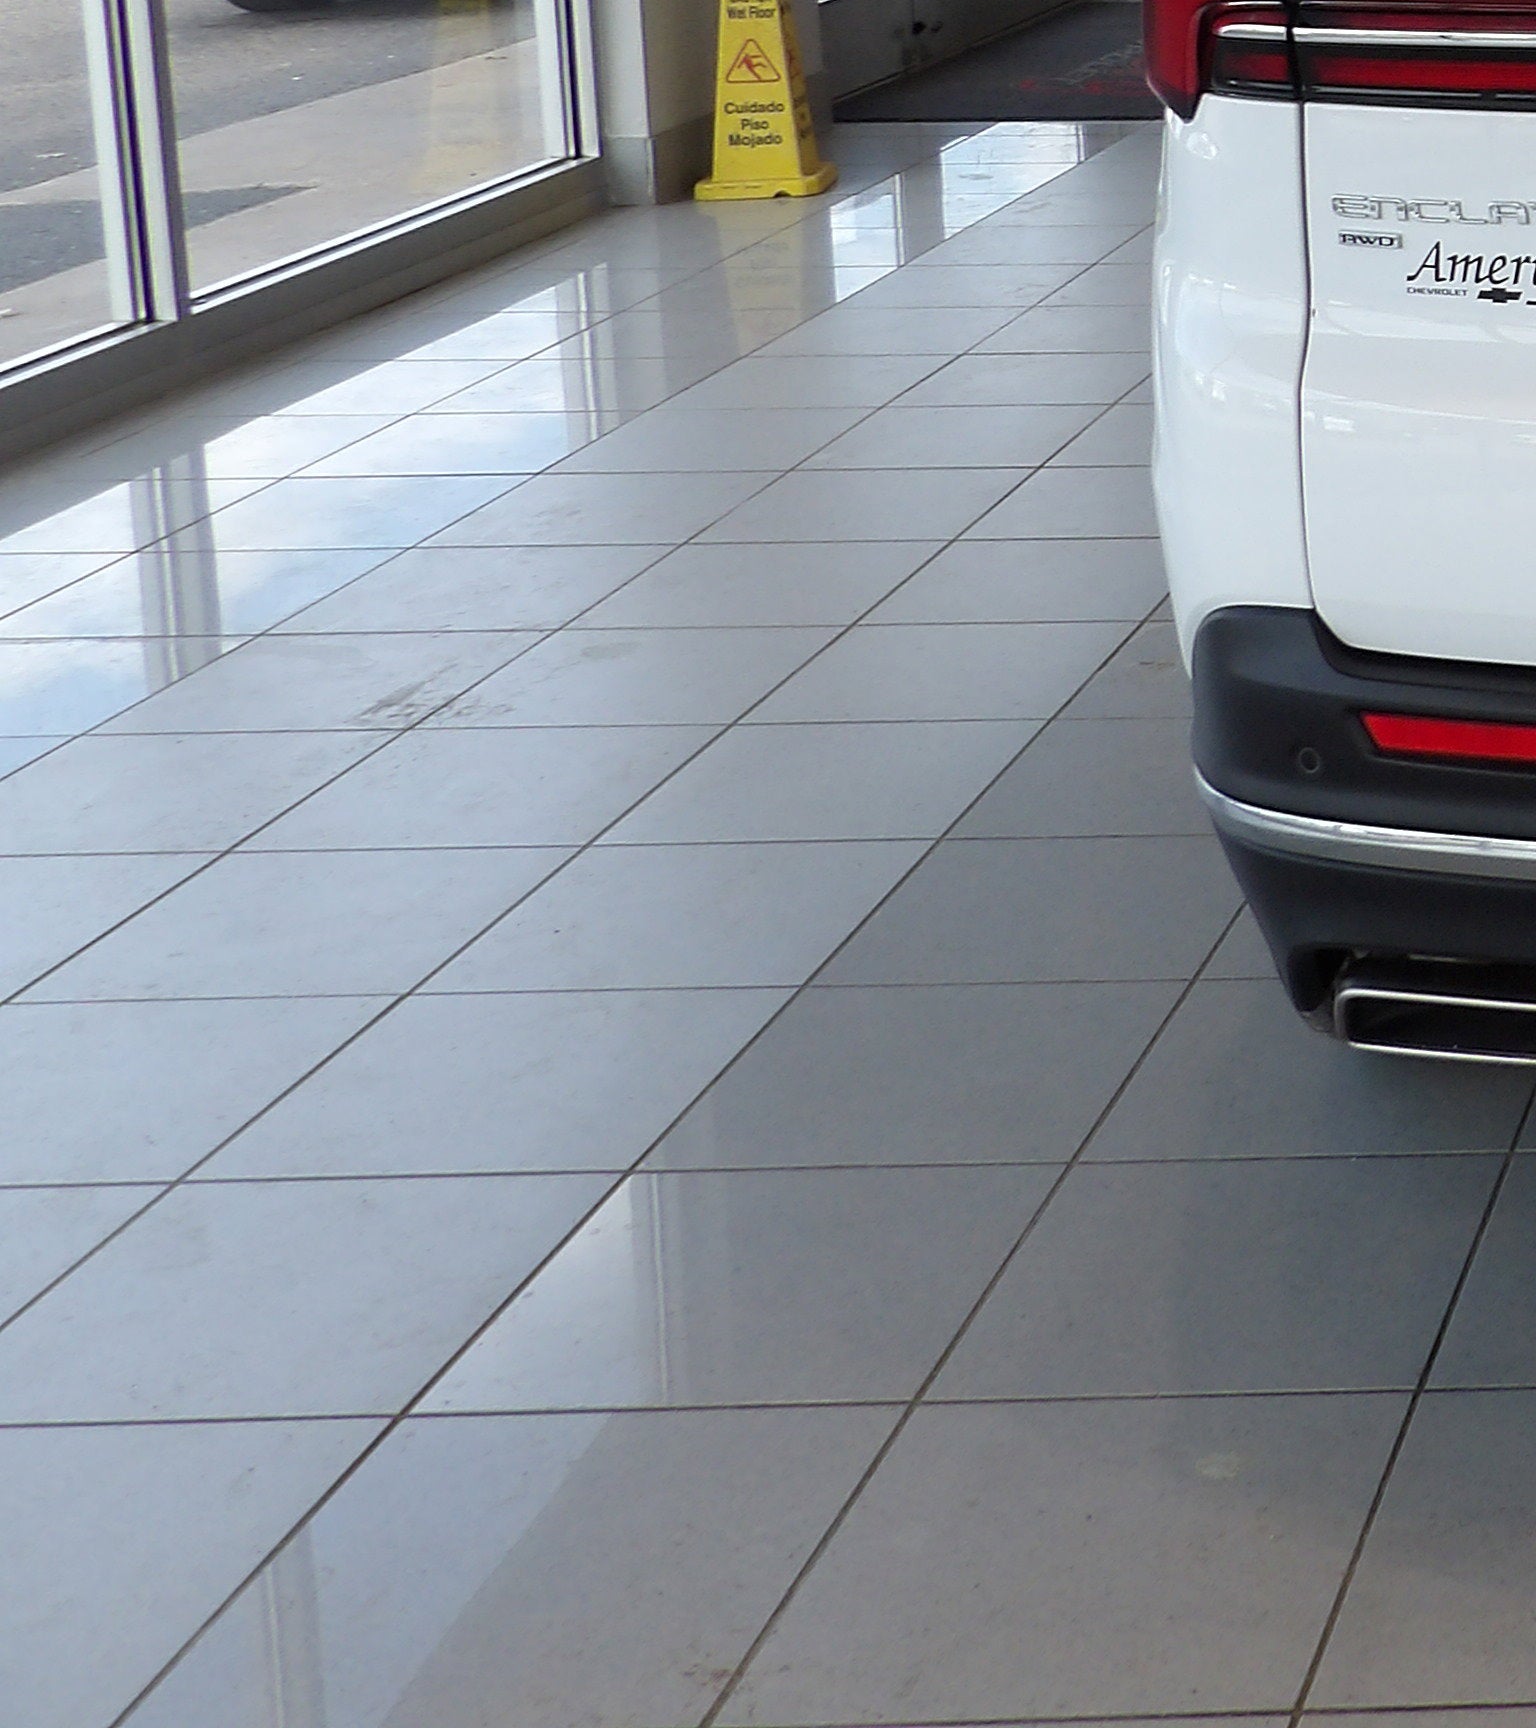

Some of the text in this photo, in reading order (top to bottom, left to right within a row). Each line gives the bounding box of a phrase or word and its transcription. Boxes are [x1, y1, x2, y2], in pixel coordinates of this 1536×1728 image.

[749, 5, 776, 19] Floor
[724, 101, 785, 114] Cuidado
[741, 117, 769, 130] Piso
[728, 132, 783, 148] Mojado
[1340, 233, 1395, 247] AWD
[1406, 286, 1468, 297] CHEVROLET
